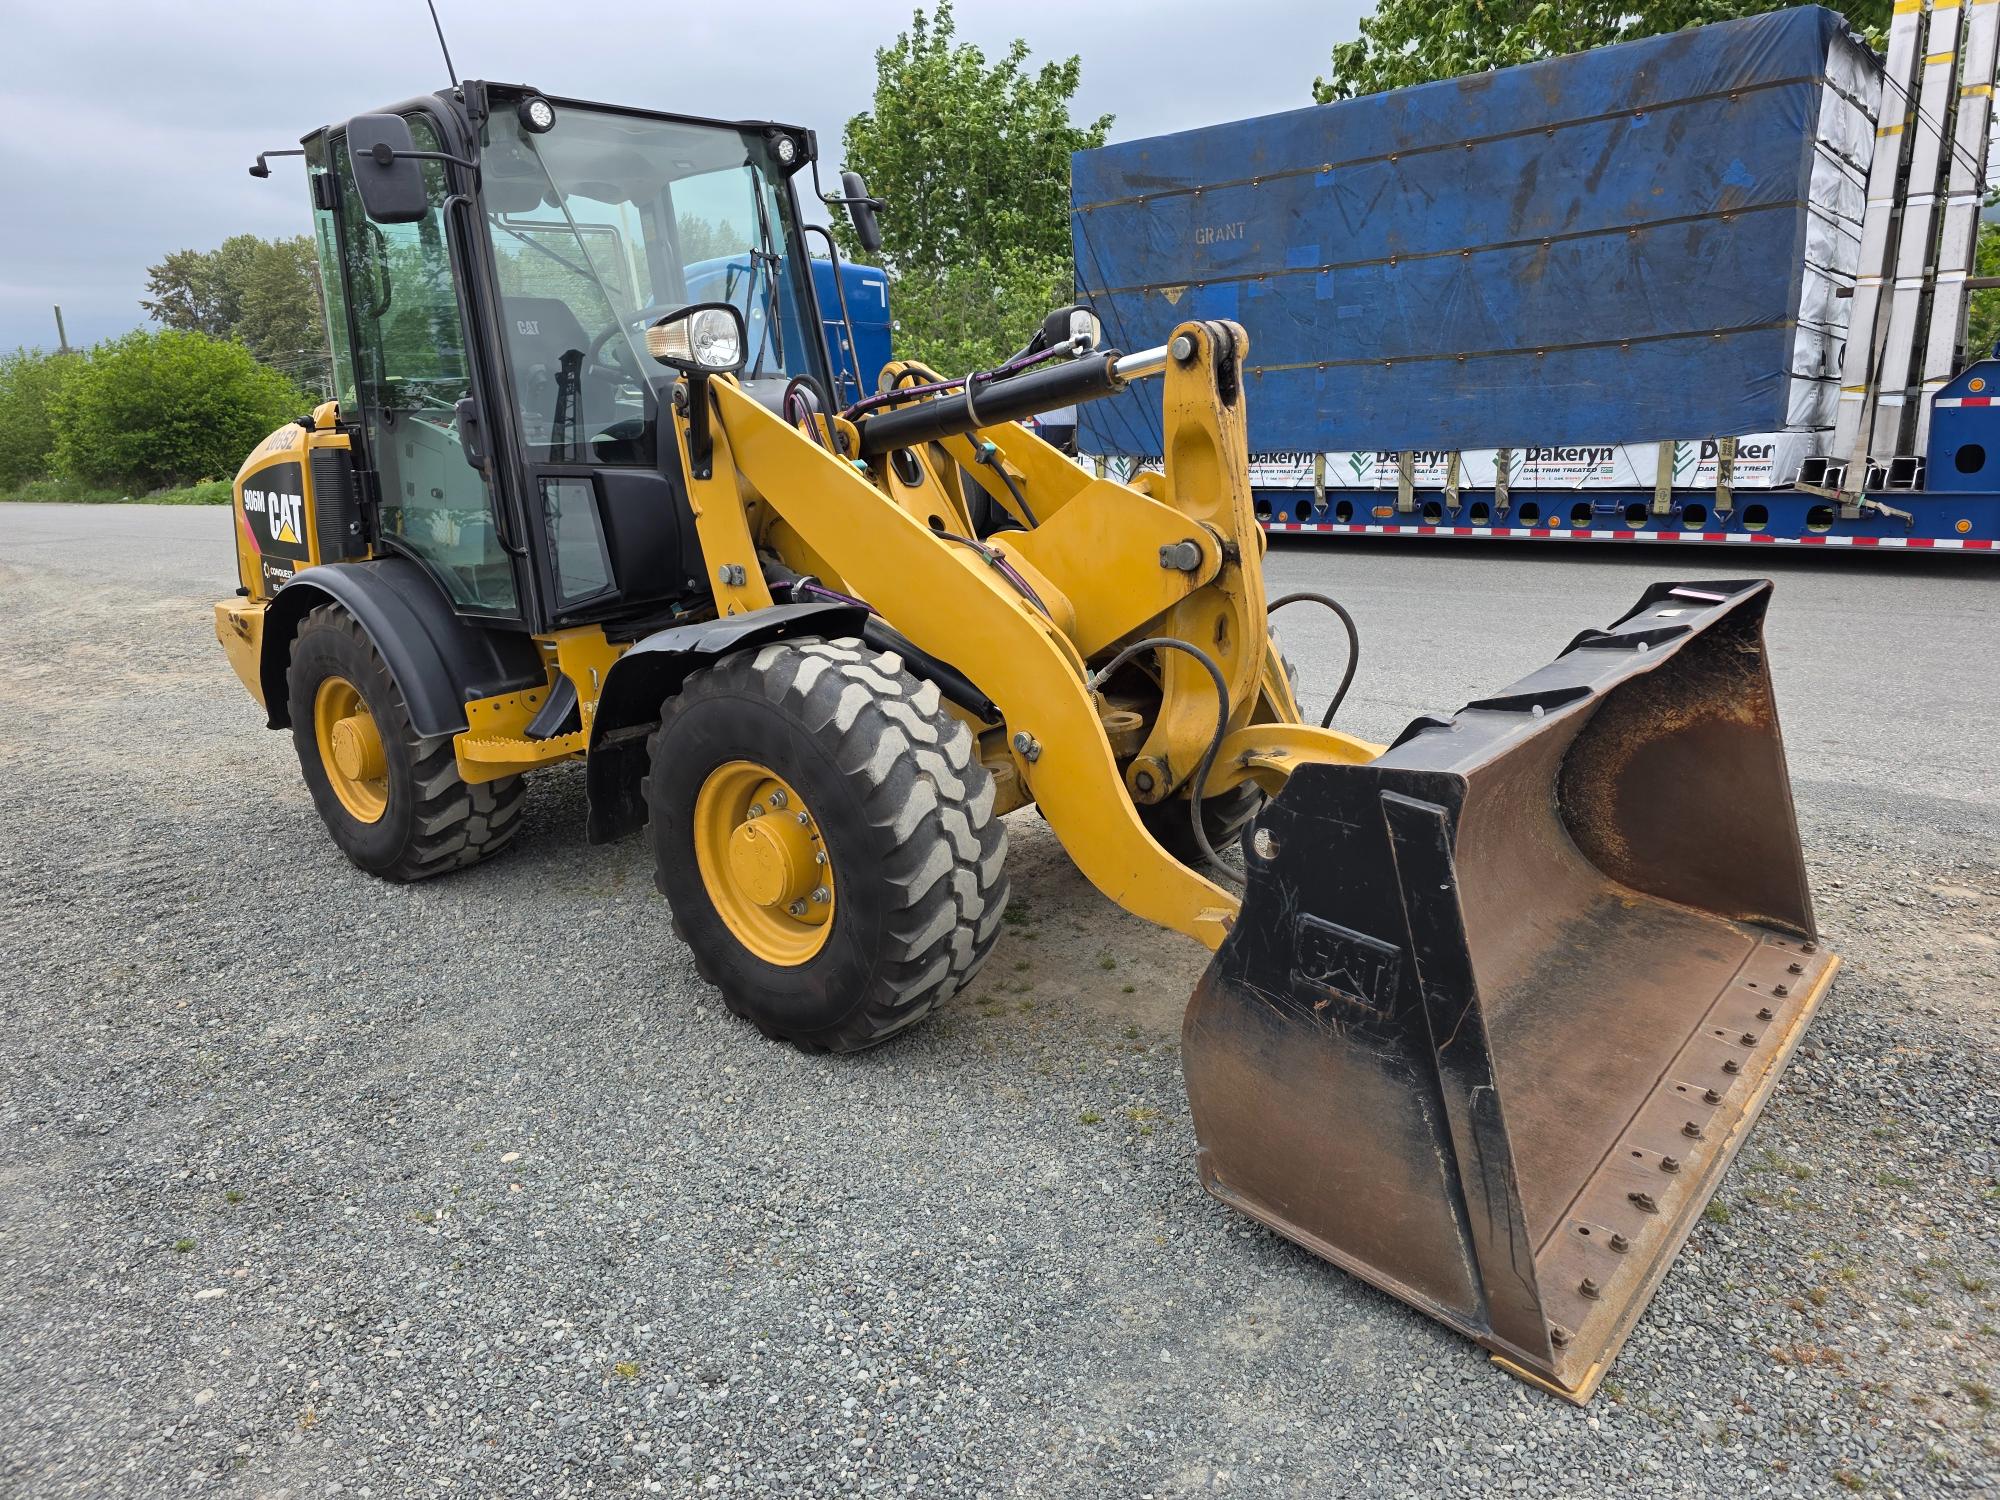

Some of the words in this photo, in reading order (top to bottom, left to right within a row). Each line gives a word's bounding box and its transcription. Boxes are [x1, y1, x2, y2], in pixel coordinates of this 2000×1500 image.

[1195, 222, 1246, 245] GRANT
[516, 320, 540, 335] CAT
[1375, 450, 1449, 468] Daeryn
[1525, 446, 1614, 467] Dakeryn
[244, 489, 266, 512] 906M
[268, 491, 302, 544] CAT
[270, 566, 293, 578] CONQUEST
[1301, 930, 1388, 1004] CAT
